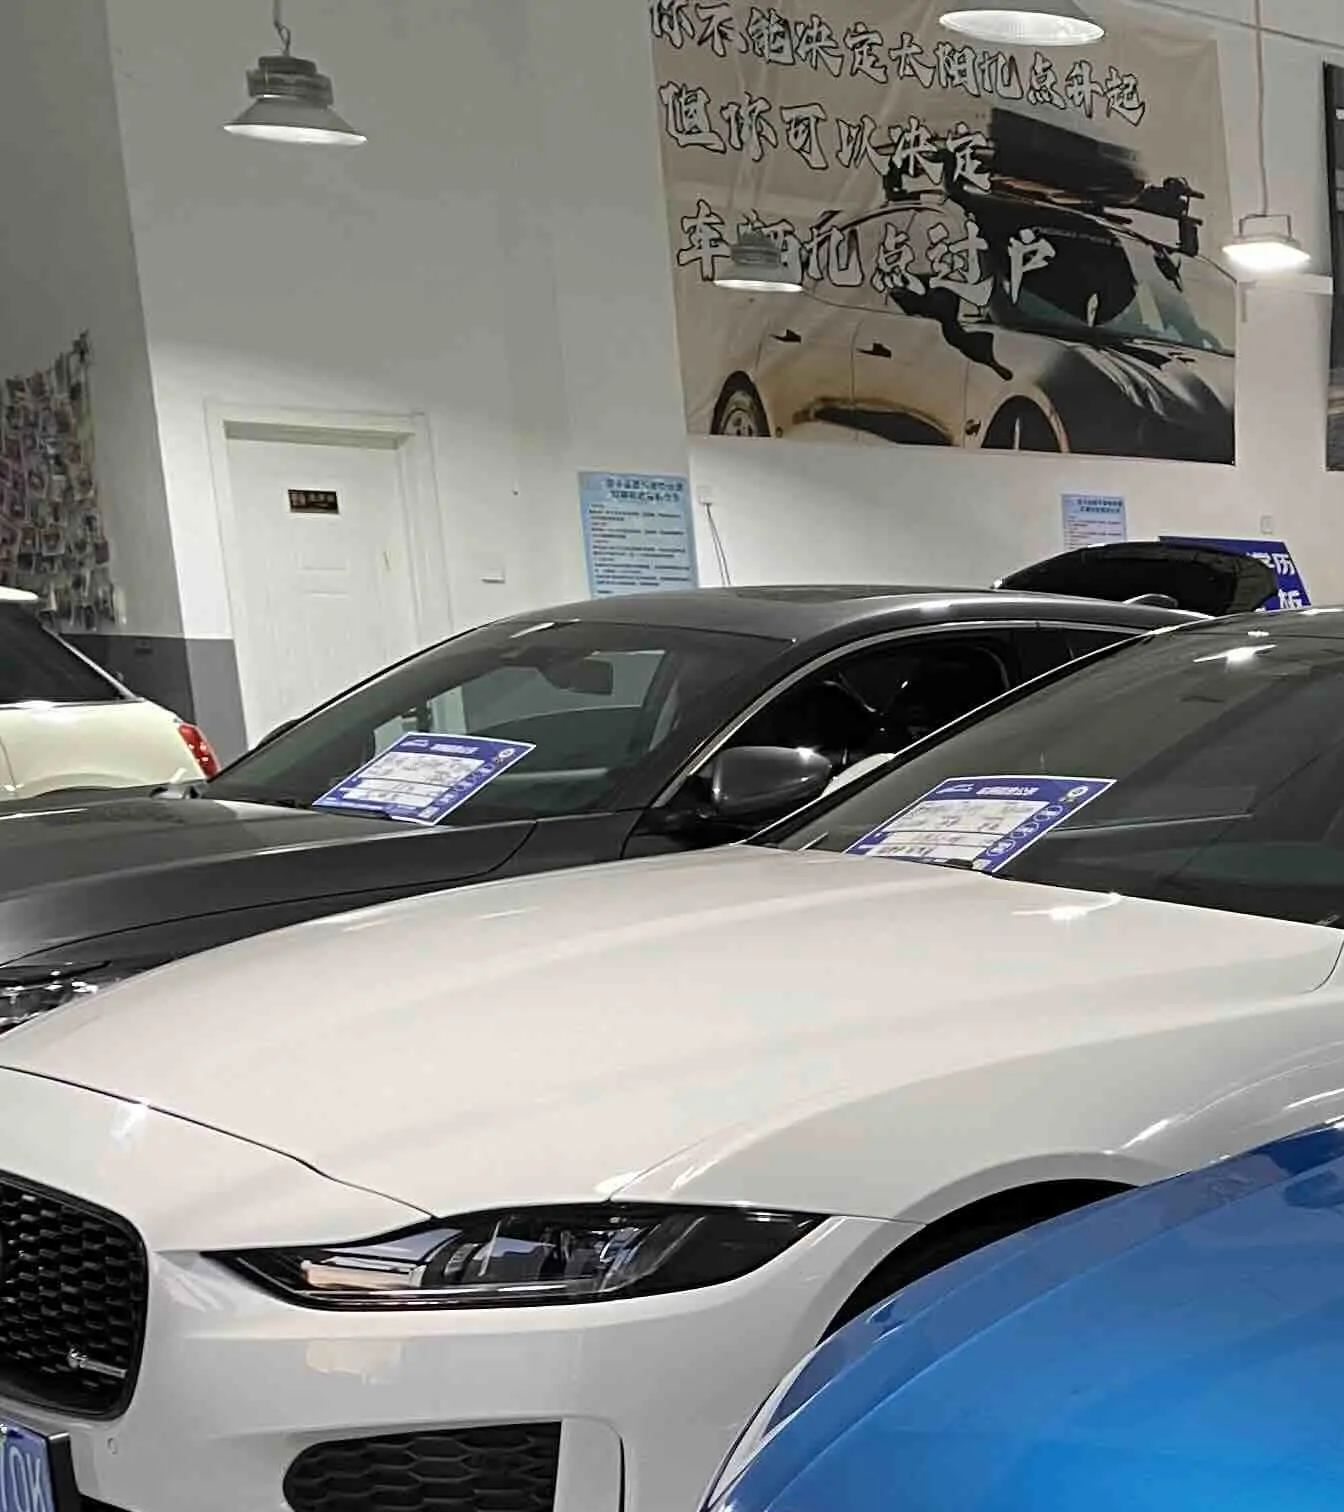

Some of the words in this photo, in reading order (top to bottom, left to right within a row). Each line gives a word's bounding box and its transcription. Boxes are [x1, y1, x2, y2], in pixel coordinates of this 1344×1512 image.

[649, 0, 1146, 126] 你不能决定太阳几点升起
[659, 81, 994, 196] 但你可以决定
